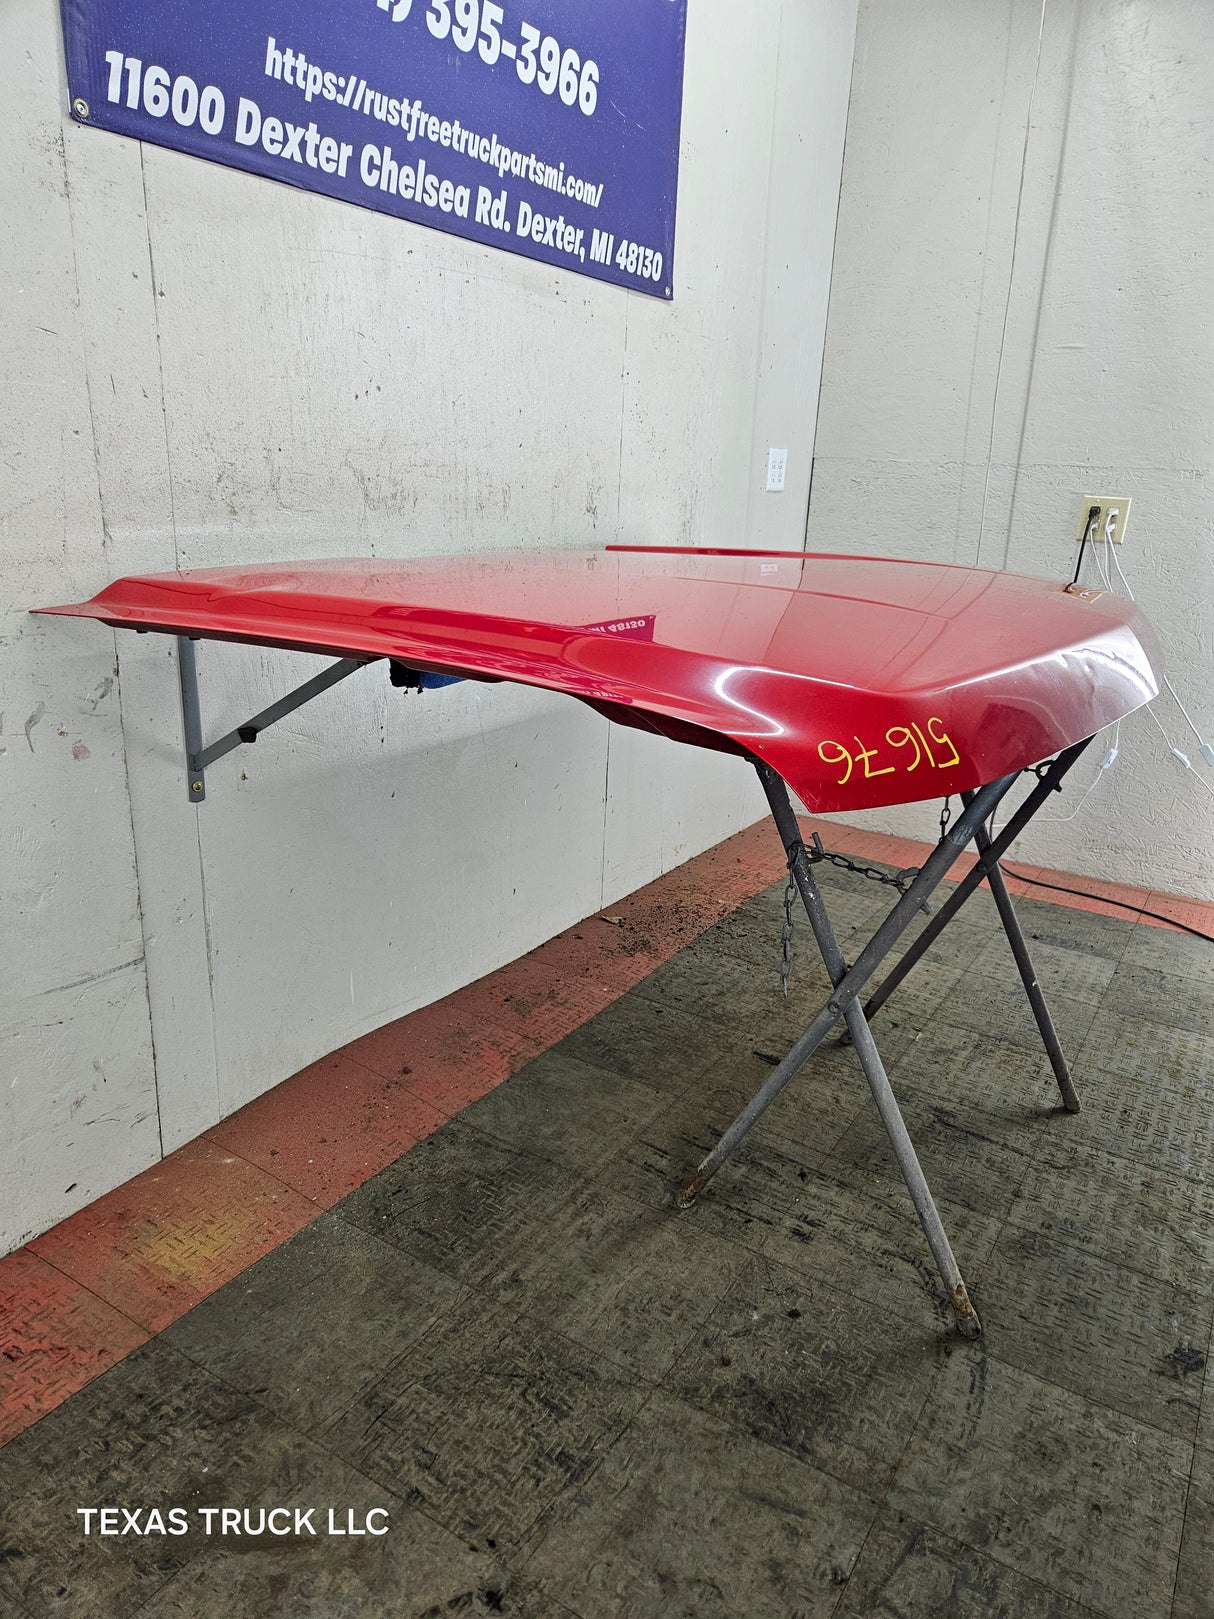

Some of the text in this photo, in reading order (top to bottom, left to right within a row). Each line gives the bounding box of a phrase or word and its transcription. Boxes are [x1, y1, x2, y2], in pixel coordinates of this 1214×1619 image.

[264, 37, 604, 208] https://rustfreetruckpartsmi.com/
[426, 0, 600, 116] 395-3966
[105, 50, 663, 282] 11600 Dexter Chelsea Rd. Dexter, MI 48130
